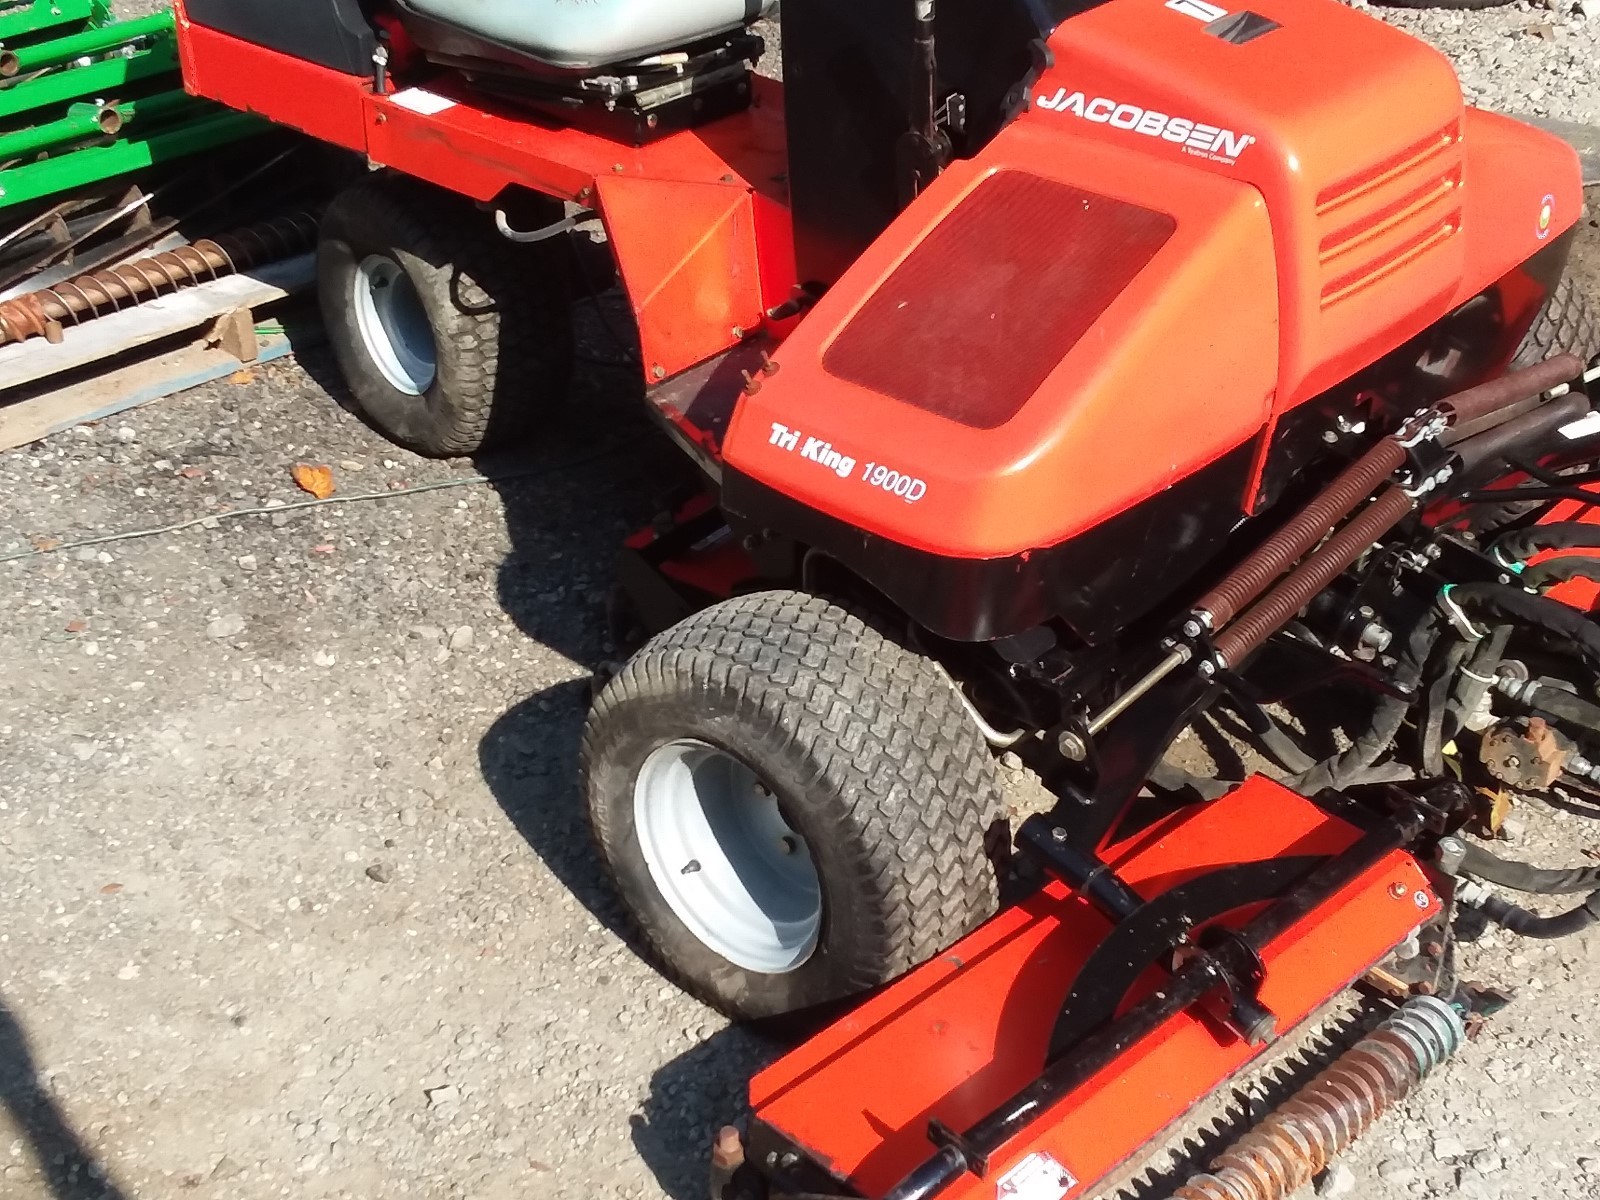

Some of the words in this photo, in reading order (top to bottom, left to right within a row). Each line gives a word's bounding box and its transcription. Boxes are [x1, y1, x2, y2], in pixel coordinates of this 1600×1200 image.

[768, 421, 802, 452] Tri
[800, 436, 857, 479] King
[861, 461, 928, 502] 1900D
